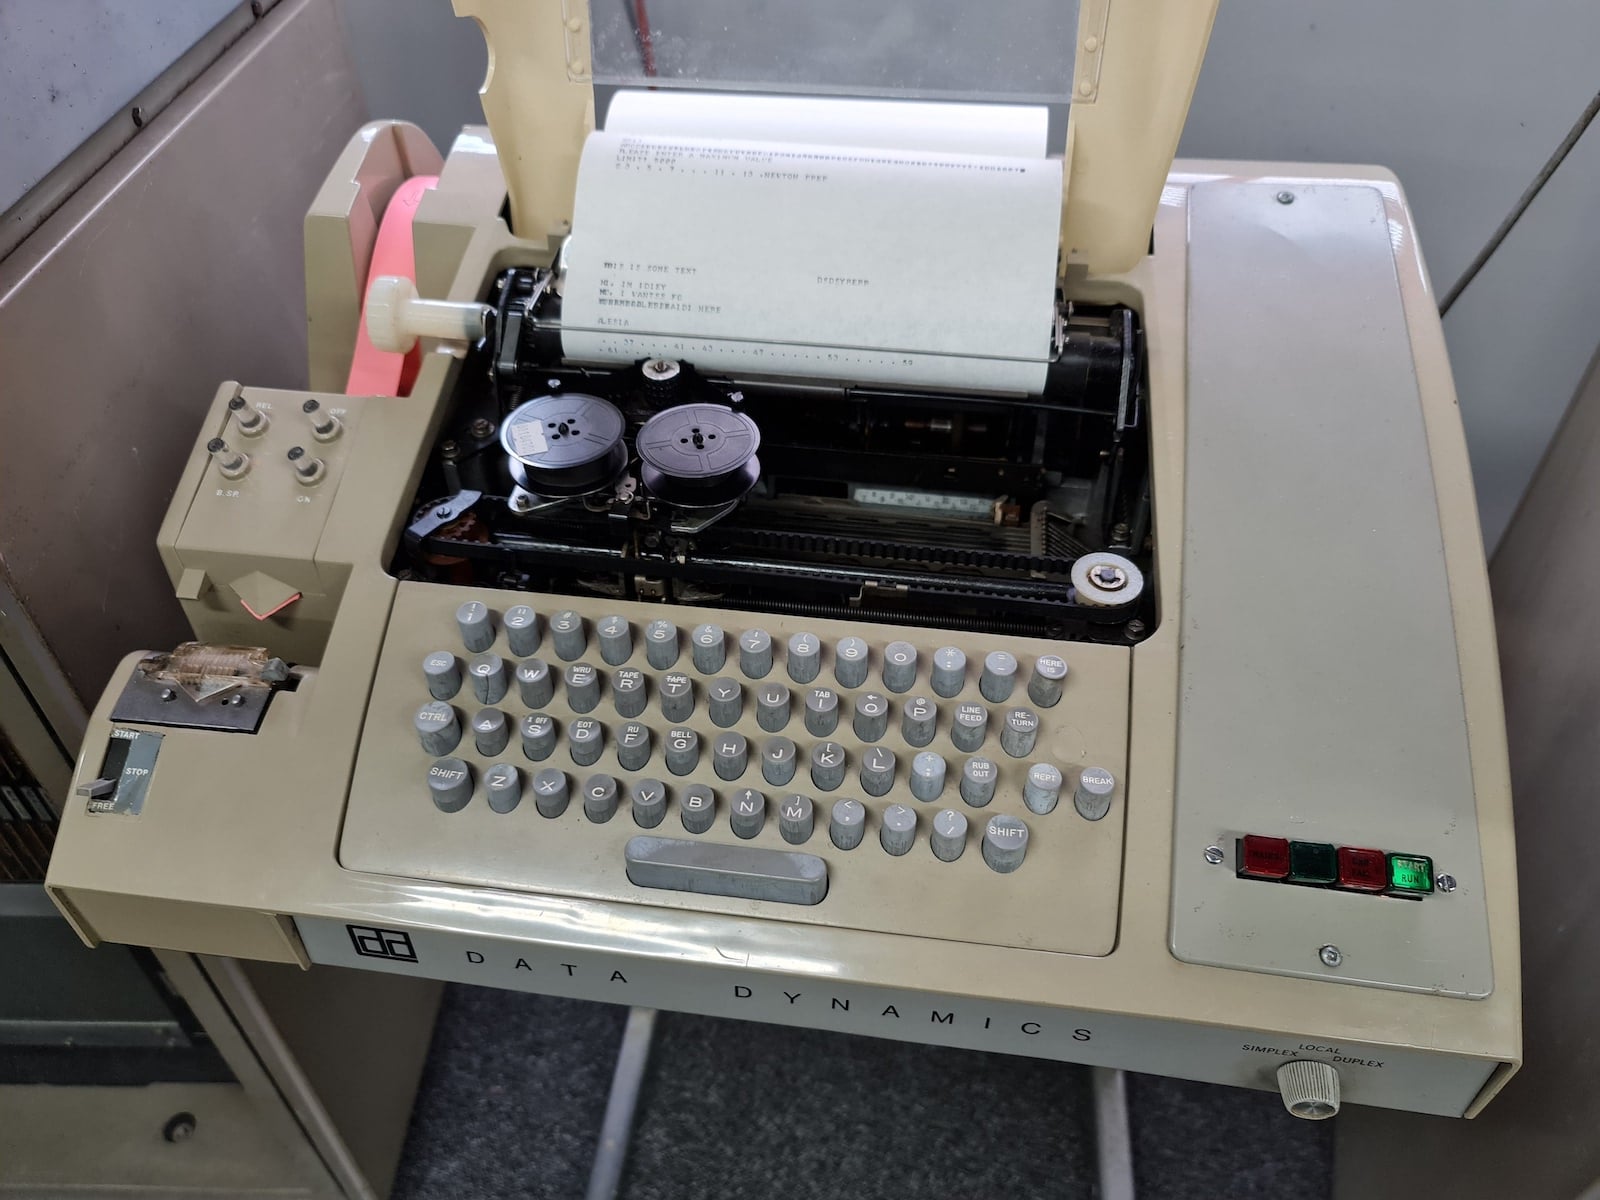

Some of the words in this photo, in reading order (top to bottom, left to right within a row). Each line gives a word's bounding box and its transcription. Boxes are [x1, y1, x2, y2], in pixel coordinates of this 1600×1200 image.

[256, 402, 273, 410] REL
[296, 495, 312, 504] ON
[511, 616, 524, 626] 2
[557, 620, 570, 630] 3
[604, 626, 618, 635] 4
[653, 630, 665, 639] 5
[700, 635, 713, 644] 6
[748, 640, 761, 649] 7
[797, 644, 810, 652] 8
[845, 648, 858, 658] 9
[1039, 658, 1063, 668] HERE
[476, 664, 490, 674] Q
[523, 669, 540, 679] W
[618, 670, 640, 678] TAPE
[572, 674, 586, 684] E
[620, 679, 634, 688] R
[668, 684, 682, 694] T
[718, 688, 731, 698] Y
[766, 693, 780, 703] U
[916, 698, 926, 706] @
[914, 707, 927, 717] P
[961, 706, 981, 714] LINE
[419, 712, 448, 722] CTRL
[960, 713, 983, 722] FEED
[478, 720, 492, 730] A
[1011, 718, 1034, 727] TURN
[528, 724, 542, 735] S
[576, 729, 590, 739] D
[671, 730, 692, 738] BELL
[114, 730, 141, 740] START
[624, 734, 638, 744] F
[674, 739, 686, 748] G
[722, 744, 736, 754] H
[772, 749, 784, 759] J
[820, 753, 834, 764] K
[872, 758, 886, 769] L
[125, 766, 150, 776] STOP
[972, 762, 990, 770] RUB
[430, 767, 464, 780] SHIFT
[972, 770, 990, 778] OUT
[1034, 772, 1056, 782] REPT
[491, 776, 506, 787] Z
[540, 780, 556, 792] X
[1082, 776, 1113, 786] BREAK
[592, 787, 605, 798] C
[640, 791, 654, 801] V
[92, 802, 116, 811] FREE
[689, 796, 702, 808] B
[740, 801, 754, 812] N
[786, 806, 803, 818] M
[988, 826, 1025, 838] SHIFT
[1401, 874, 1420, 884] RUN
[466, 950, 628, 984] DATA
[734, 985, 1092, 1042] DYNAMICS
[1242, 1044, 1298, 1058] SIMPLEX
[1299, 1043, 1341, 1056] LOCAL
[1332, 1056, 1385, 1068] DUPLEX
